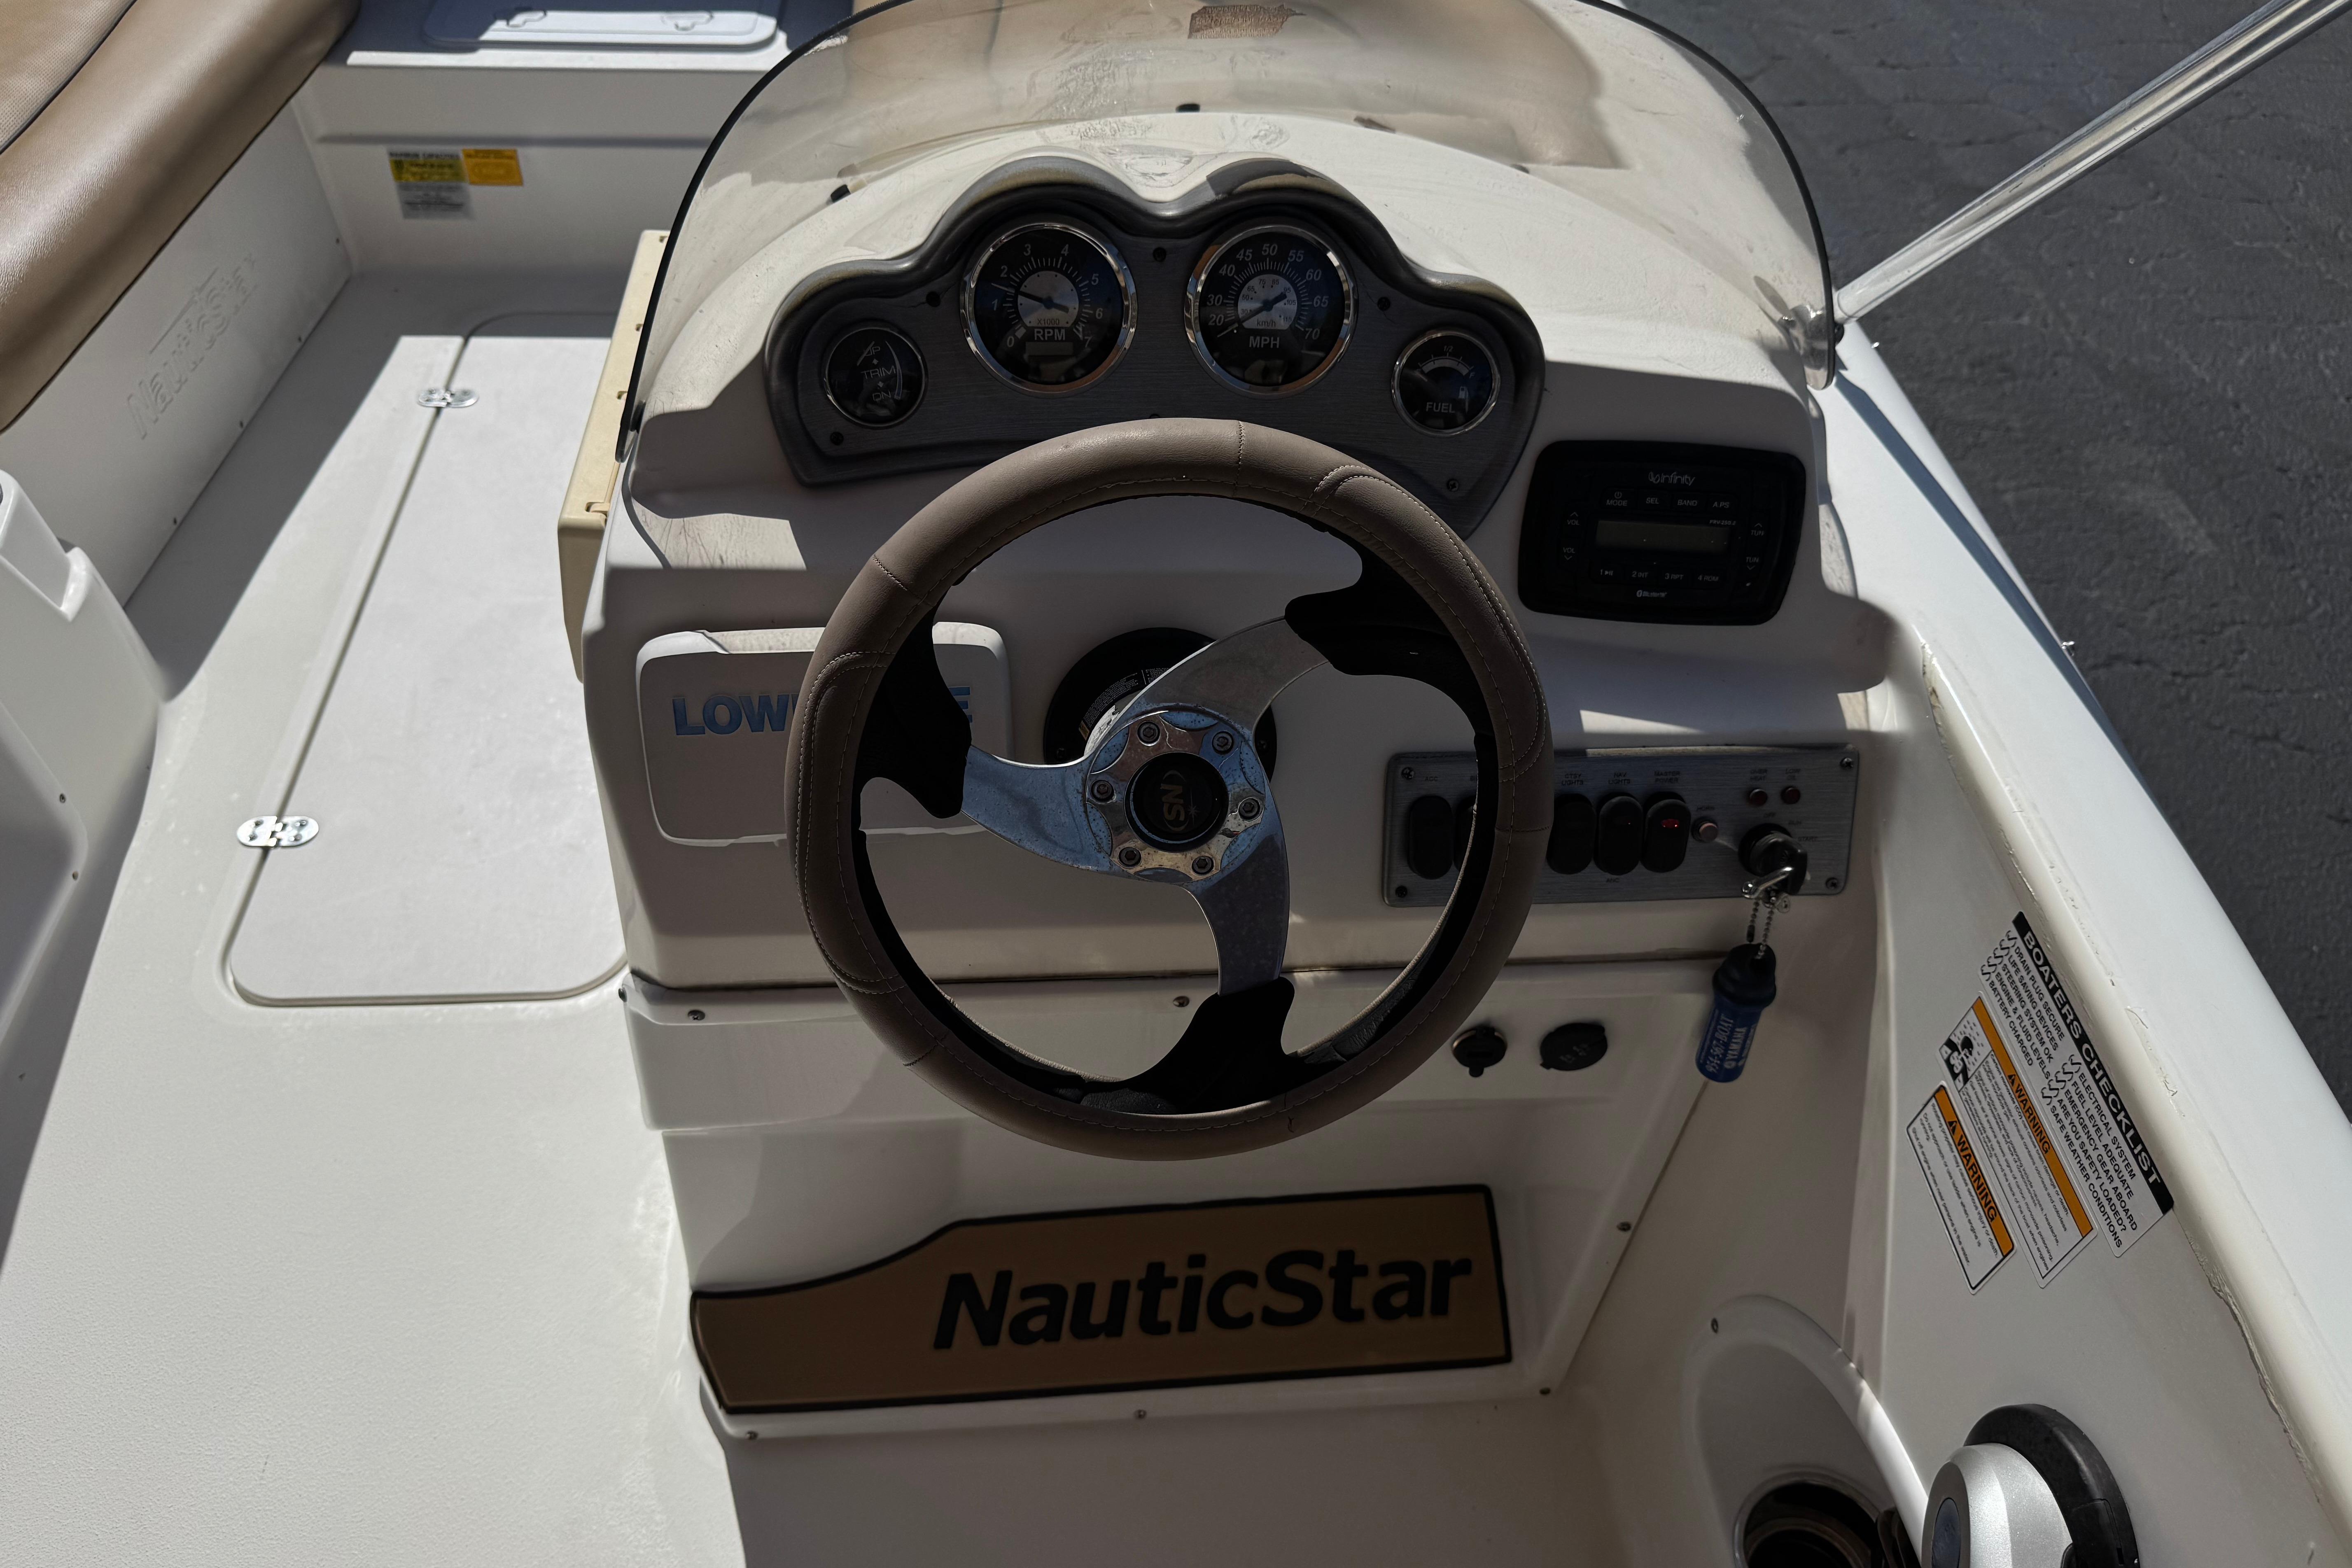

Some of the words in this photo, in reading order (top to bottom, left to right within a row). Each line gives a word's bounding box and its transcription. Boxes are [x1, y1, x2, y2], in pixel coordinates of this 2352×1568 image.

[1024, 244, 1031, 255] 3
[1061, 245, 1069, 256] 4
[1237, 250, 1252, 261] 45
[1262, 244, 1277, 255] 50
[1288, 250, 1304, 261] 55
[1001, 266, 1008, 277] 2
[1219, 264, 1235, 276] 40
[1306, 269, 1321, 280] 60
[1092, 274, 1099, 285] 5
[992, 299, 998, 310] 1
[1207, 295, 1223, 306] 30
[1314, 296, 1329, 307] 65
[1096, 308, 1103, 319] 6
[1209, 315, 1224, 325] 20
[1257, 319, 1276, 327] km/h
[1034, 329, 1065, 341] RPM
[1304, 329, 1320, 339] 70
[1007, 337, 1014, 347] 0
[1085, 337, 1092, 348] 7
[1249, 336, 1280, 348] MPH
[861, 366, 896, 379] TRIM
[1426, 402, 1455, 413] FUEL
[2014, 945, 2031, 976] DRAIN
[2029, 974, 2044, 1002] PLUG
[2042, 1000, 2065, 1041] SECURE
[2008, 954, 2020, 976] LIFE
[2018, 974, 2037, 1010] SAVING
[2035, 1008, 2058, 1052] DEVICES
[2001, 962, 2026, 1010] STEERING
[2023, 1007, 2045, 1048] SYSTEM
[2043, 1045, 2053, 1064] OK
[1988, 979, 2011, 1021] BATTERY
[2008, 1019, 2034, 1067] CHARGED
[1995, 971, 2014, 1007] ENGINE
[2011, 1005, 2018, 1015] &
[2016, 1013, 2032, 1043] FLUID
[2030, 1041, 2051, 1080] LEVELS
[2023, 930, 2083, 1041] BOATERS
[2080, 1040, 2161, 1189] CHECKLIST
[2014, 1104, 2023, 1120] (CO)
[2014, 1083, 2051, 1155] WARNING
[2079, 1072, 2113, 1136] ELECTRICAL
[2110, 1135, 2136, 1180] SYSTEM
[2071, 1080, 2087, 1108] FUEL
[2085, 1108, 2105, 1143] LEVEL
[2102, 1141, 2134, 1200] ADEQUATE
[2056, 1096, 2070, 1120] ARE
[2068, 1119, 2081, 1141] YOU
[2078, 1140, 2102, 1183] SAFETY
[2099, 1182, 2127, 1233] LOADED?
[2064, 1088, 2098, 1154] EMERGENCY
[2096, 1153, 2114, 1185] GEAR
[2112, 1184, 2138, 1232] ABOARD
[1956, 1134, 1998, 1223] WARNING
[2049, 1104, 2066, 1133] SAFE
[2063, 1131, 2090, 1183] WEATHER
[2088, 1182, 2123, 1248] CONDITIONS
[1976, 1209, 1987, 1230] injury
[1984, 1228, 1990, 1237] or
[1988, 1236, 1999, 1258] death.
[2036, 1246, 2049, 1272] engines
[933, 1249, 1472, 1349] NauticStar
